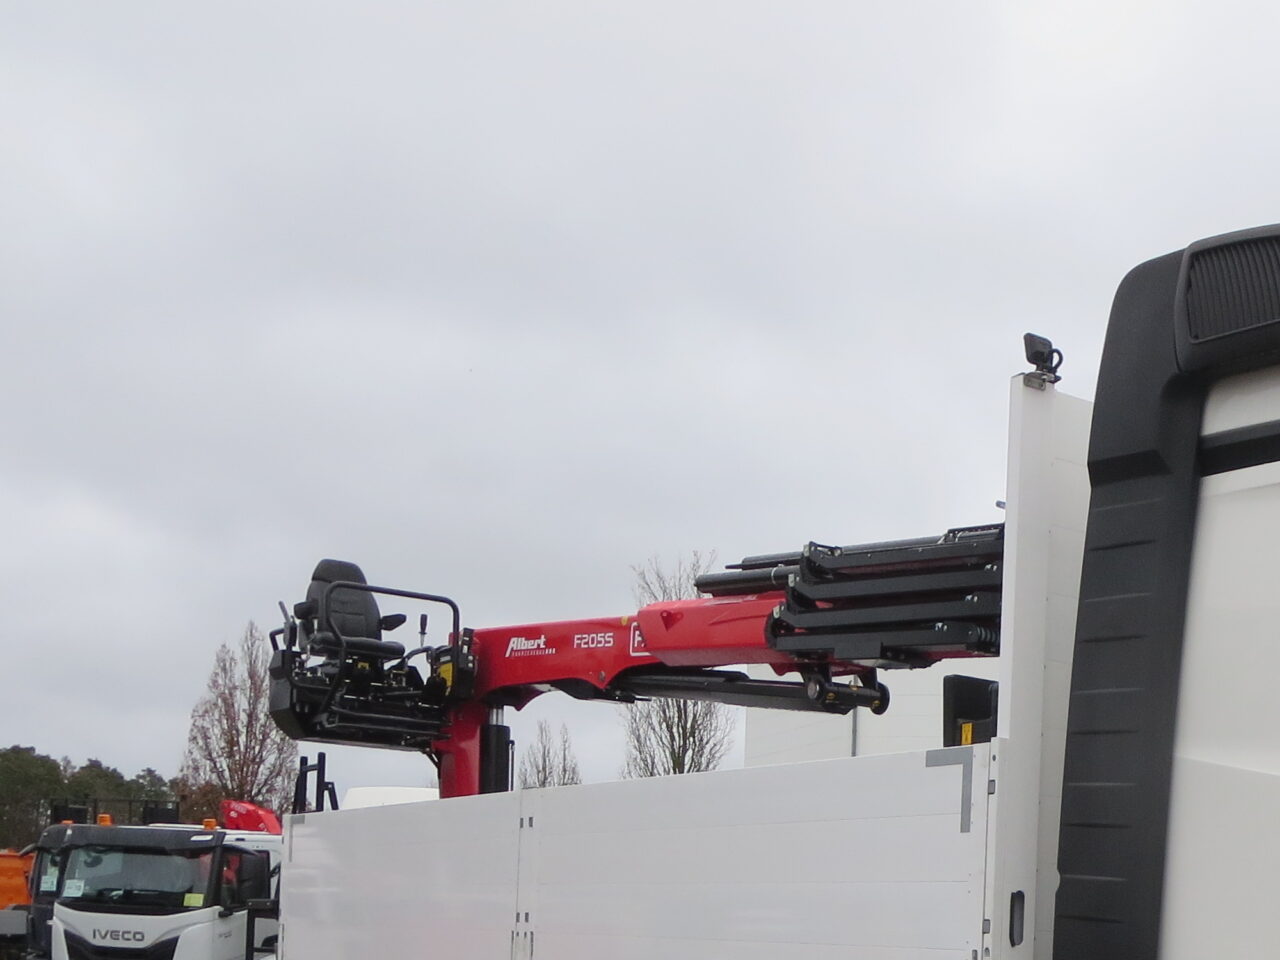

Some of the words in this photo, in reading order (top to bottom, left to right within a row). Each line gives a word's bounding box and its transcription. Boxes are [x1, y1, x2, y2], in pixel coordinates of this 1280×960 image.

[505, 634, 546, 657] Albert
[573, 632, 614, 648] F205S
[92, 928, 145, 942] IVECO
